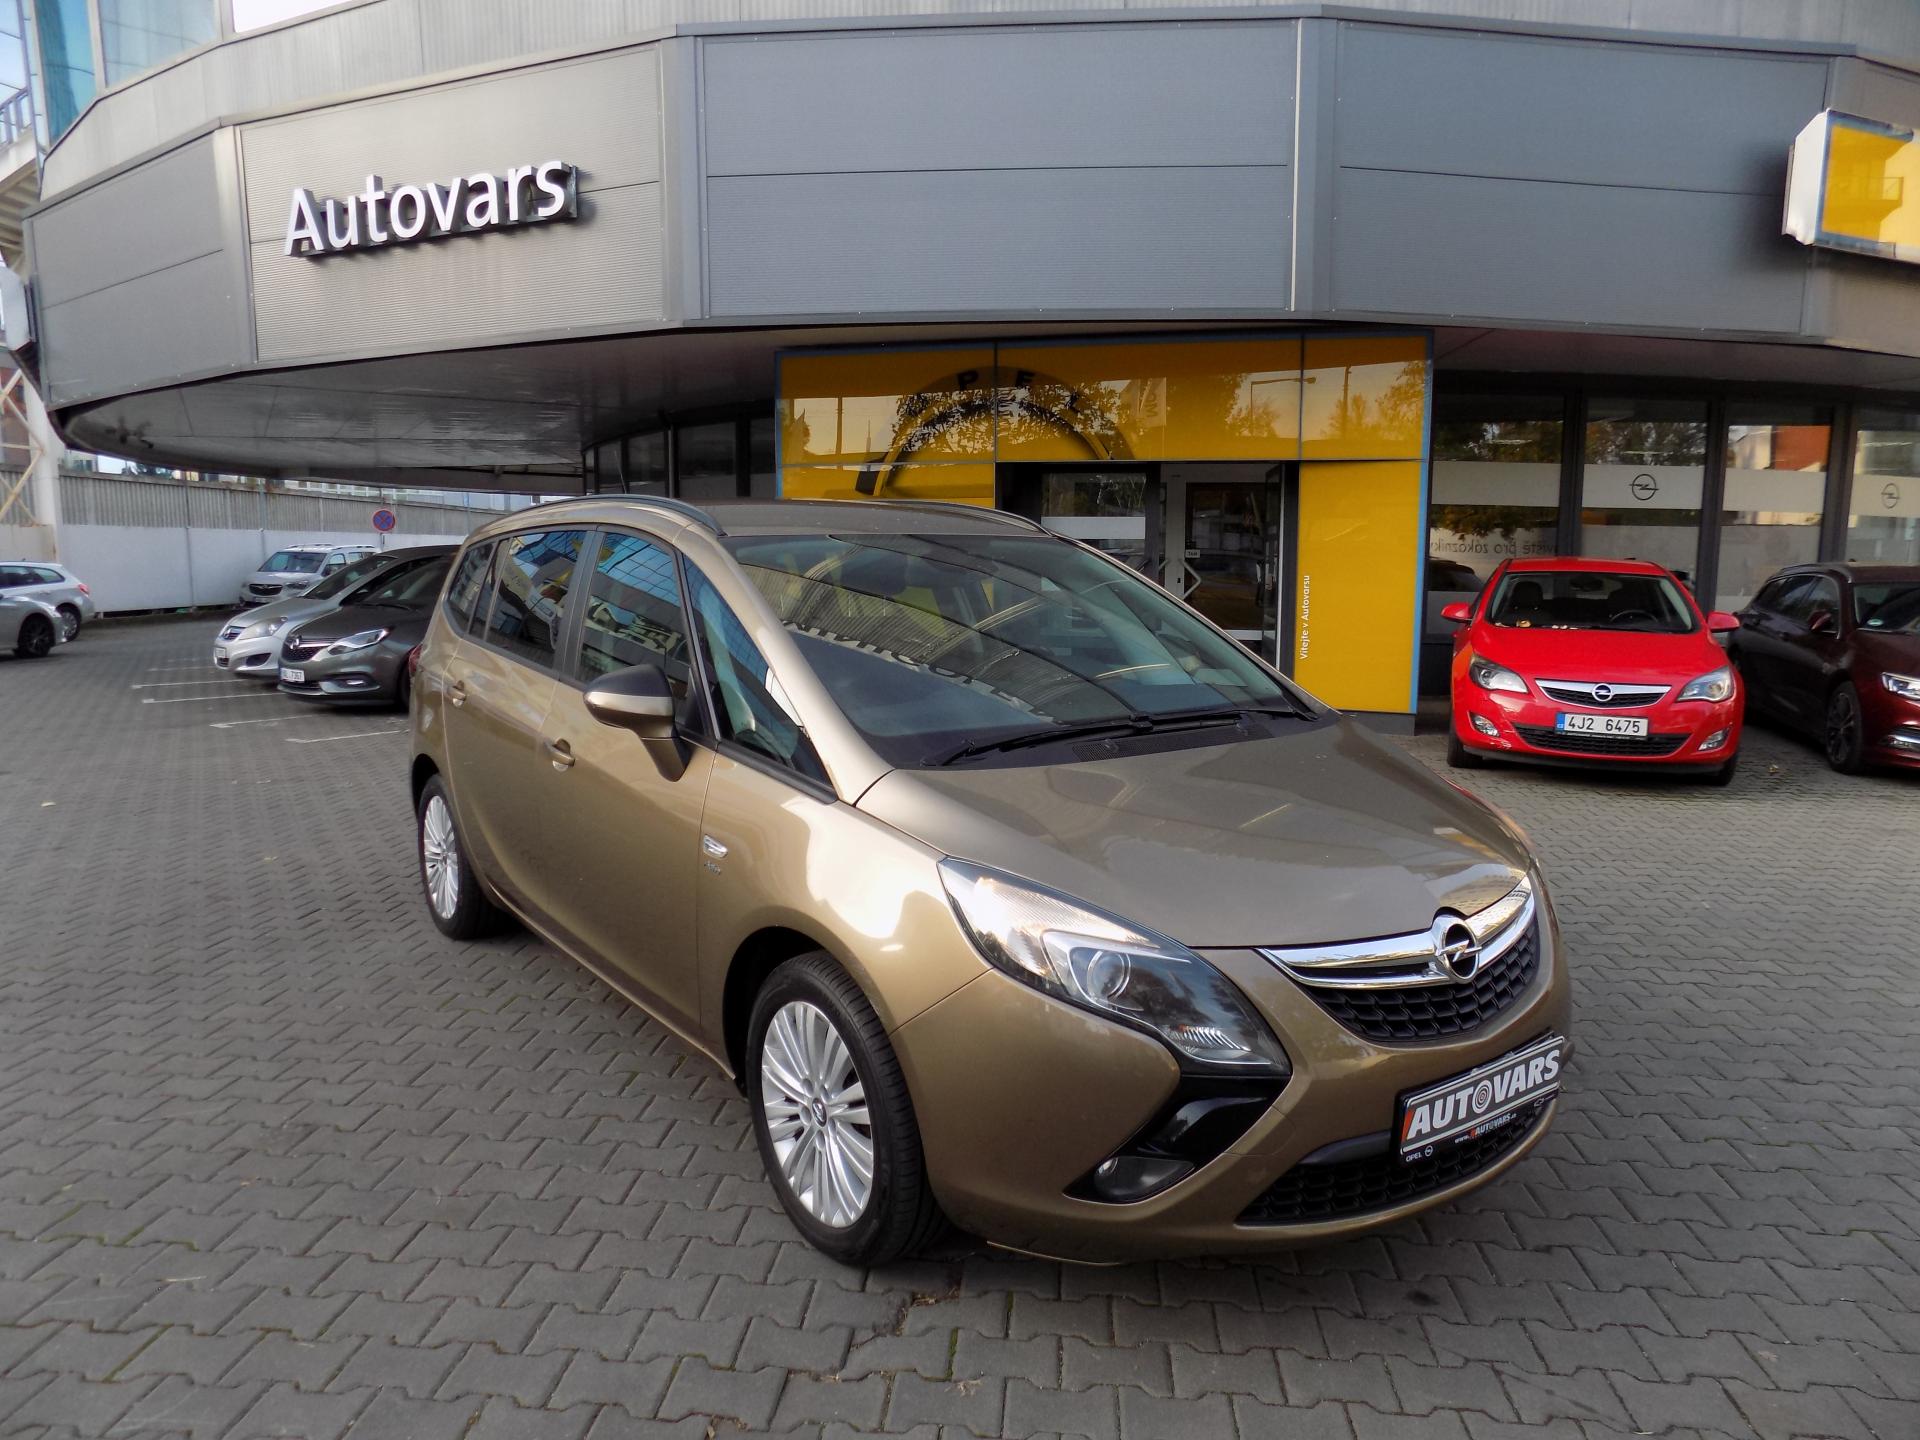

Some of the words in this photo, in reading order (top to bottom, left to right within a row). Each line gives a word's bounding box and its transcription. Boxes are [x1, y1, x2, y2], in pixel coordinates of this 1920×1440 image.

[285, 160, 571, 256] Autovars
[1301, 575, 1310, 620] Autovarsu
[1568, 716, 1594, 730] 4J2
[1605, 719, 1641, 733] 6475
[1406, 1049, 1560, 1140] AUTOVARS
[1405, 1151, 1422, 1163] OPEL
